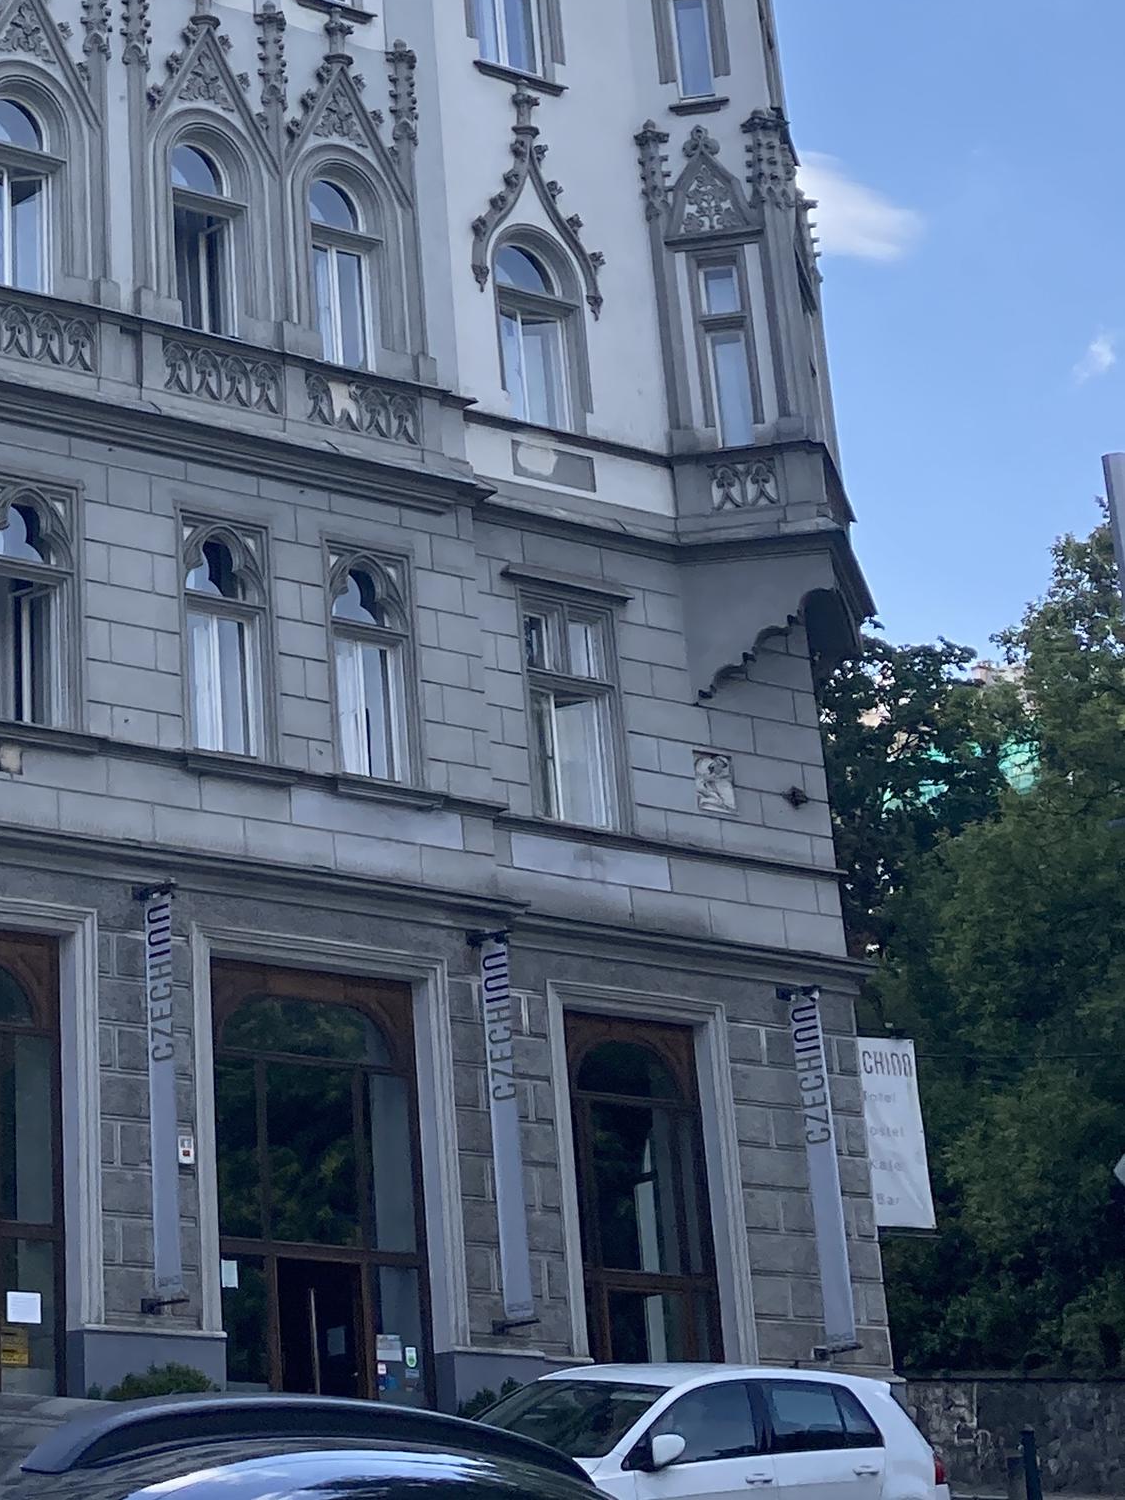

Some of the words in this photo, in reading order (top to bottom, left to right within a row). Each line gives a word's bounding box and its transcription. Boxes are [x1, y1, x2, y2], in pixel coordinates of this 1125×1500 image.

[148, 904, 175, 1062] CZECHINN
[484, 952, 517, 1100] CZECHINN
[791, 1004, 831, 1145] CZECHINN
